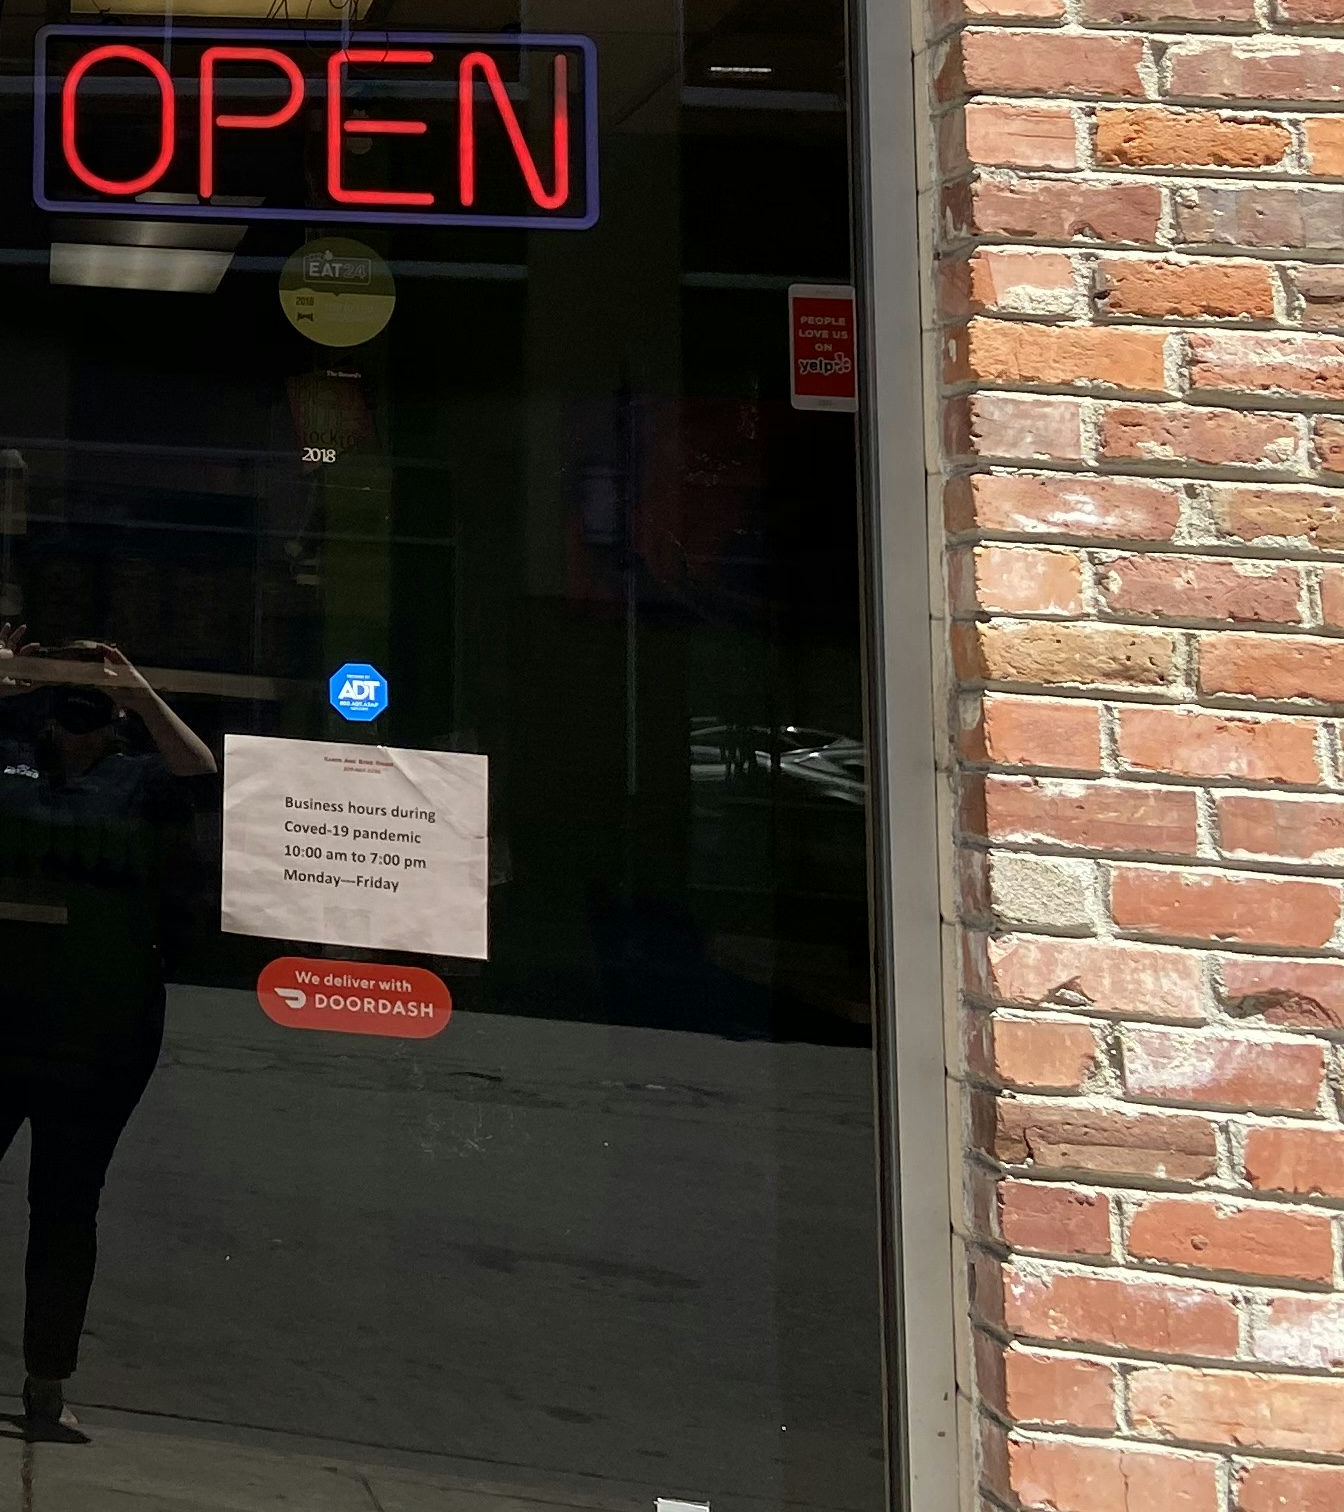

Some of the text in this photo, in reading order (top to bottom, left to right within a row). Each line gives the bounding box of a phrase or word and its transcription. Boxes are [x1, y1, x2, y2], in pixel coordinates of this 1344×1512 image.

[62, 44, 569, 210] OPEN
[308, 261, 368, 280] EAT24
[800, 316, 846, 326] PEOPLE
[798, 329, 849, 340] LOVE US
[814, 343, 833, 352] ON
[798, 357, 835, 376] yelp
[302, 447, 337, 464] 2018
[337, 679, 381, 701] ADT
[284, 796, 436, 823] Business hours during
[284, 820, 422, 845] Coved-19 pandemic
[284, 845, 427, 870] 10:00 am to 7:00 pm
[295, 970, 412, 993] We deliver with
[314, 993, 434, 1018] DOORDASH
